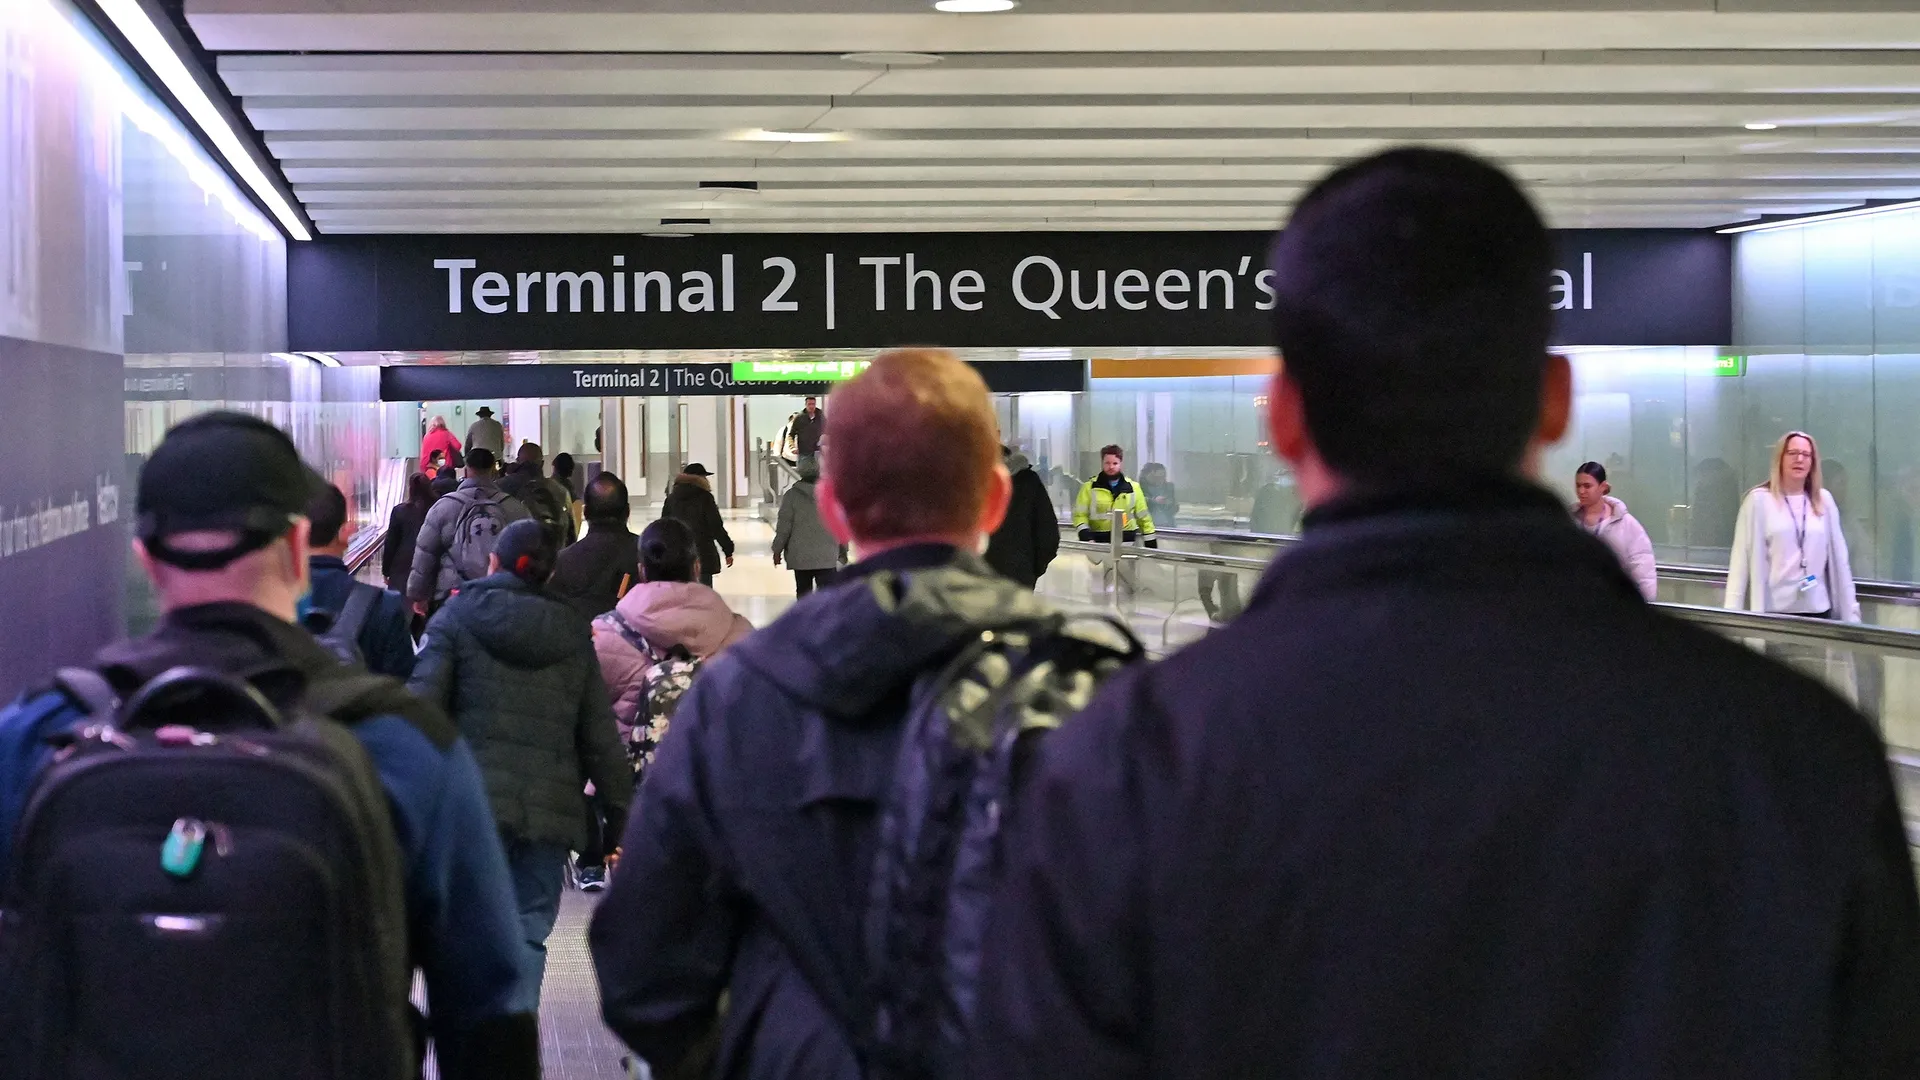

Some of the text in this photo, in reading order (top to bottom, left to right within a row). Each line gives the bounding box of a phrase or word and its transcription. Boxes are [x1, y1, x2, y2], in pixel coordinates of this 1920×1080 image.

[433, 253, 735, 314] Terminal
[761, 256, 799, 312] 2
[859, 252, 986, 311] The
[1011, 255, 1278, 320] Queen's
[573, 368, 645, 388] Terminal
[649, 368, 660, 387] 2
[673, 367, 706, 387] The
